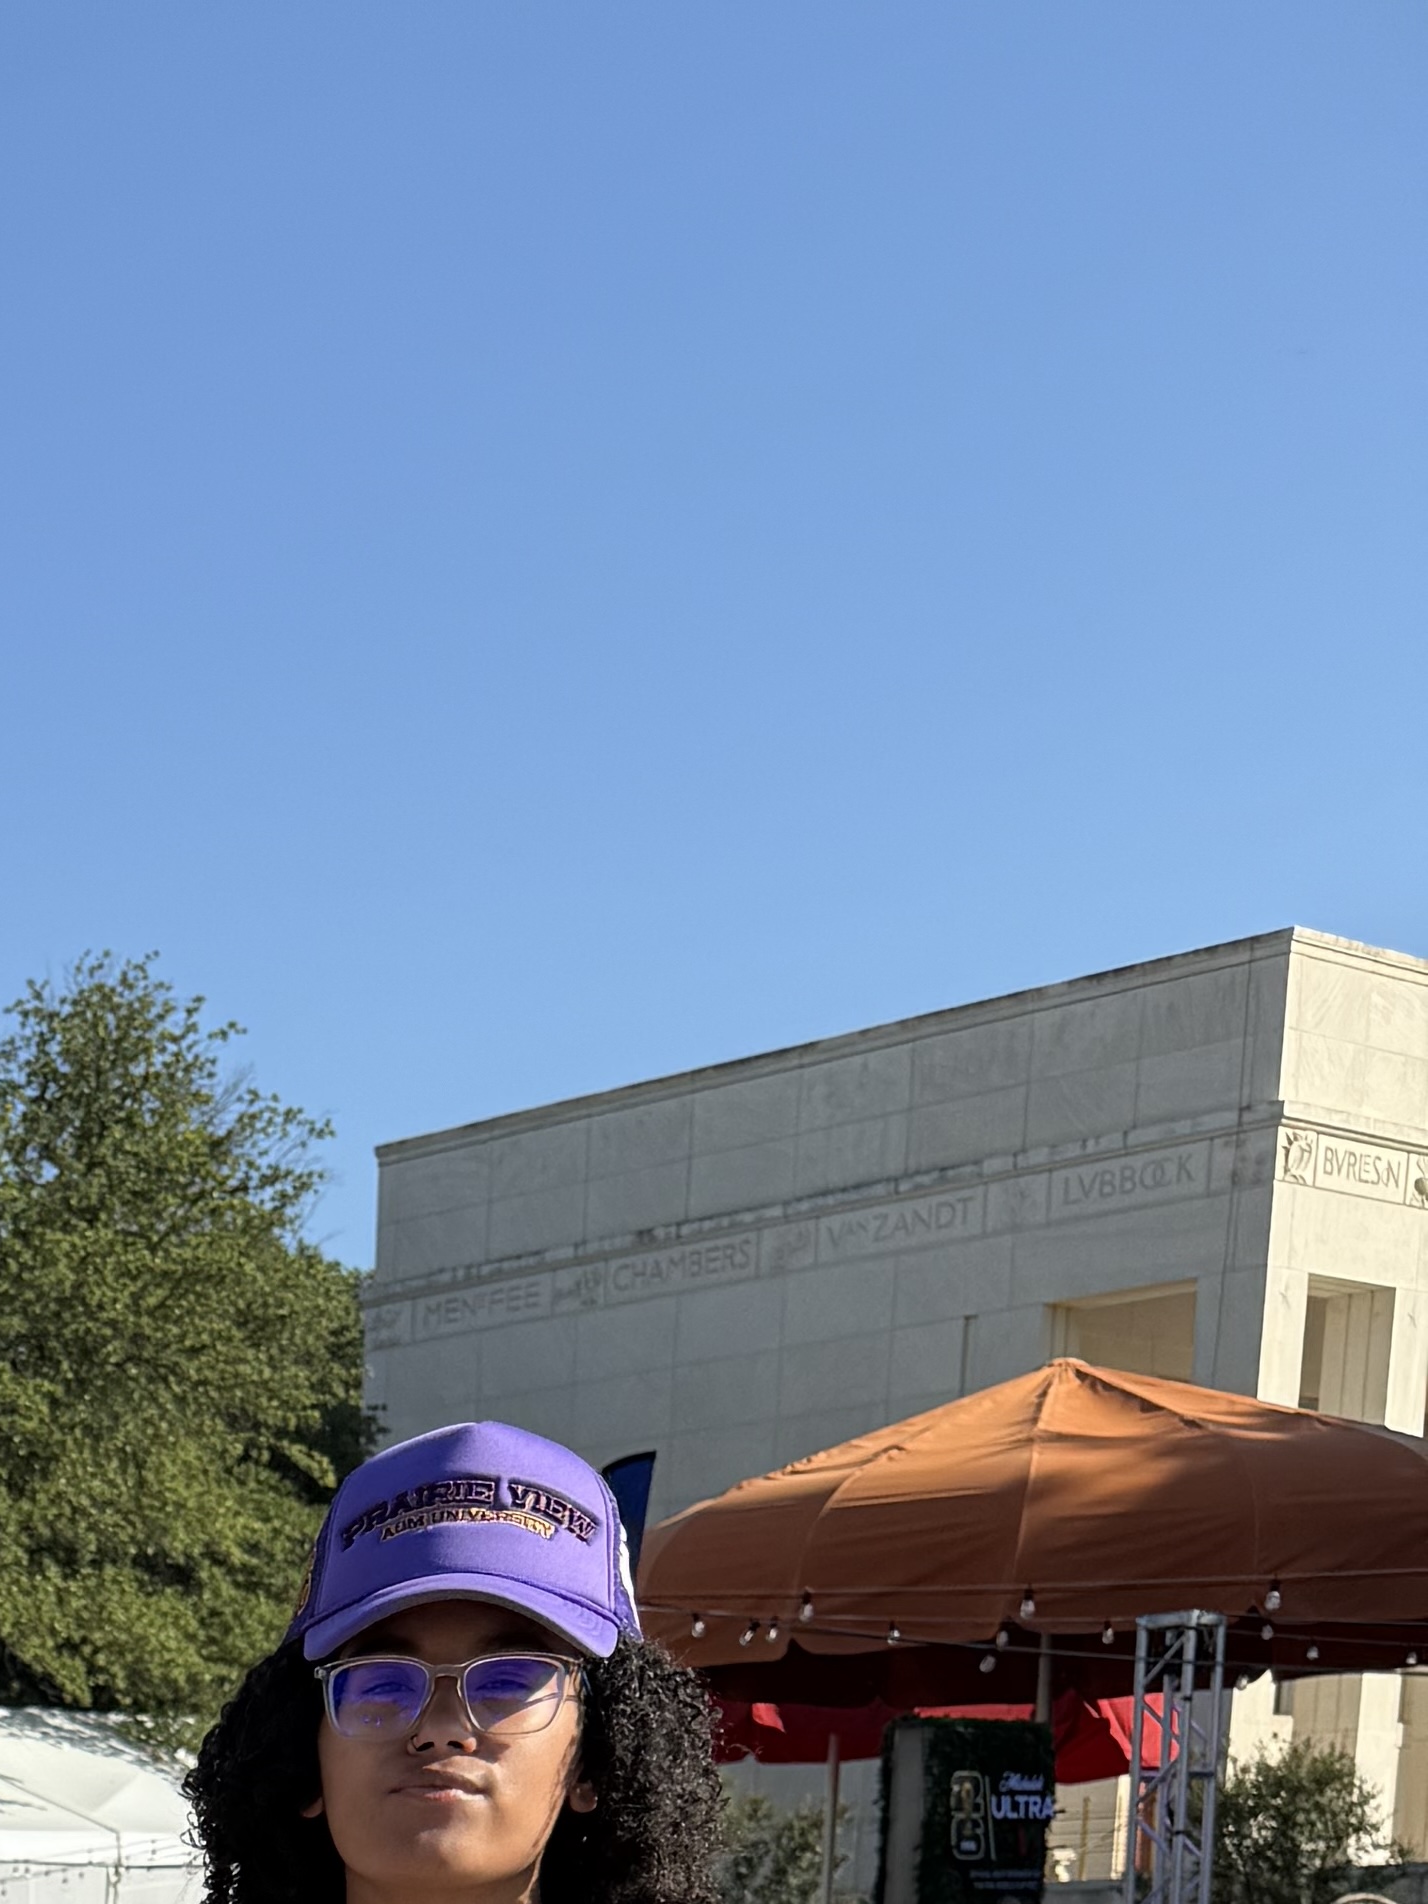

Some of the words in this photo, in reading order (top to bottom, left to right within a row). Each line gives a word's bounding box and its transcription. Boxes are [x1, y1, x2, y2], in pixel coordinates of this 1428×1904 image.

[611, 1239, 752, 1293] CHAMBERS
[342, 1477, 496, 1551] PRAIRIE
[507, 1479, 600, 1546] VIEW
[431, 1508, 556, 1541] UNIVERSITY
[990, 1793, 1056, 1821] ULTRA
